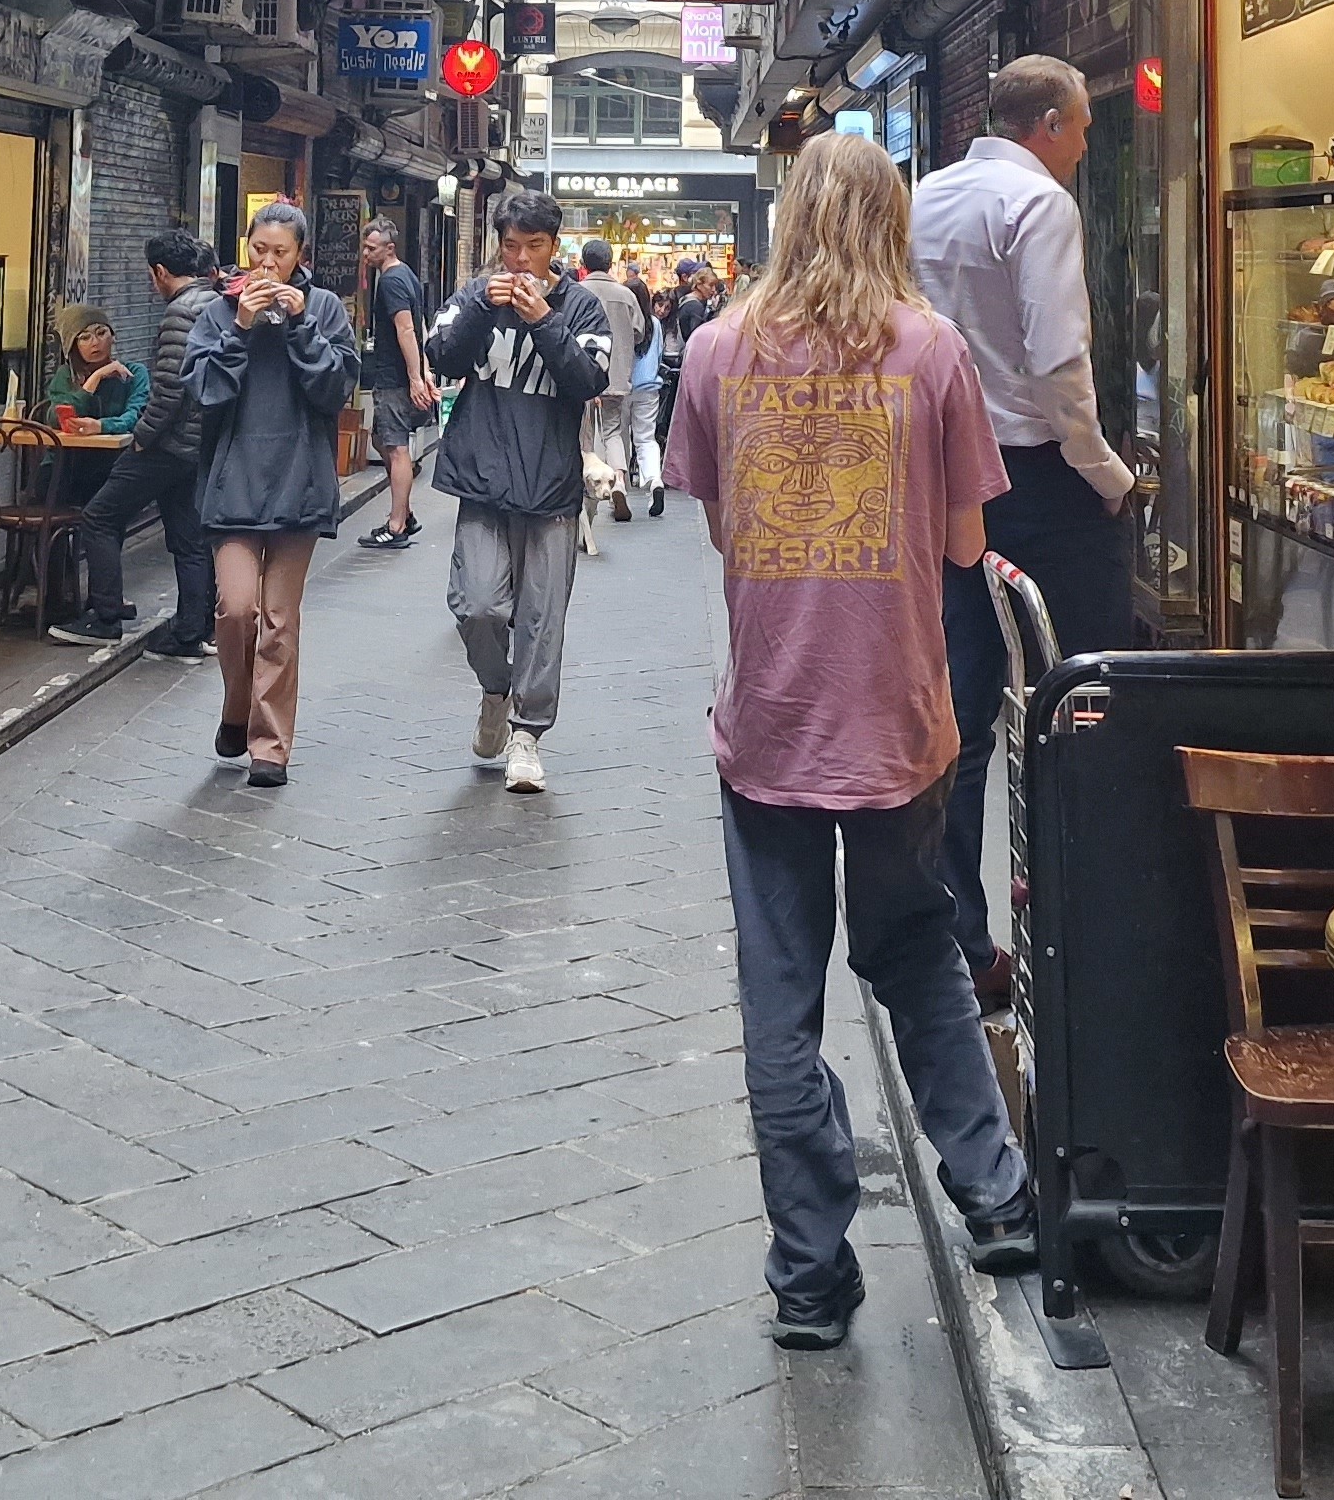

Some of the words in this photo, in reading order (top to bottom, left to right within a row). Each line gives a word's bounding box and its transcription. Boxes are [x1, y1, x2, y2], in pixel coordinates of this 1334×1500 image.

[349, 24, 418, 49] Yen
[341, 49, 377, 71] Sushi
[557, 175, 611, 191] KOKO
[617, 176, 680, 192] BLACK
[735, 382, 895, 414] PACIFIC
[734, 539, 888, 572] RESORT
